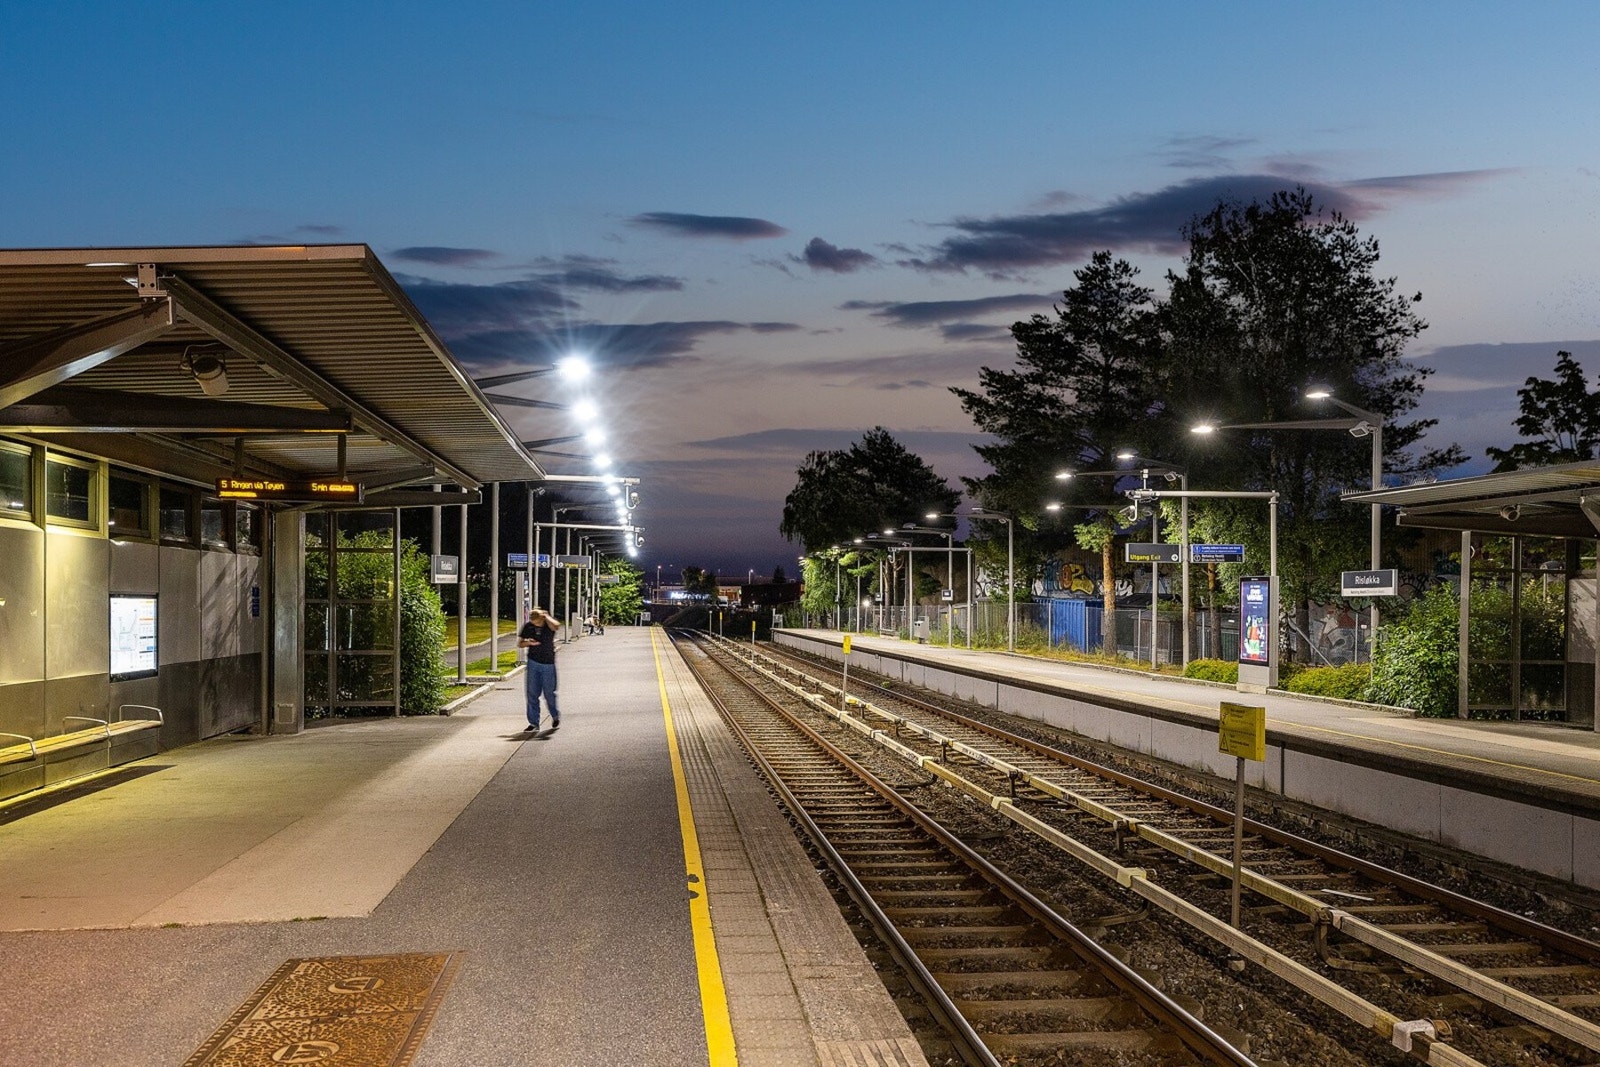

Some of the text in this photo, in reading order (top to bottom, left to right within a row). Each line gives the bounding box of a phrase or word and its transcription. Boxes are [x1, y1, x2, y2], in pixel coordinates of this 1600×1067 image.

[221, 480, 228, 489] 5
[231, 480, 254, 490] Ringen
[1354, 575, 1380, 585] Risløkka
